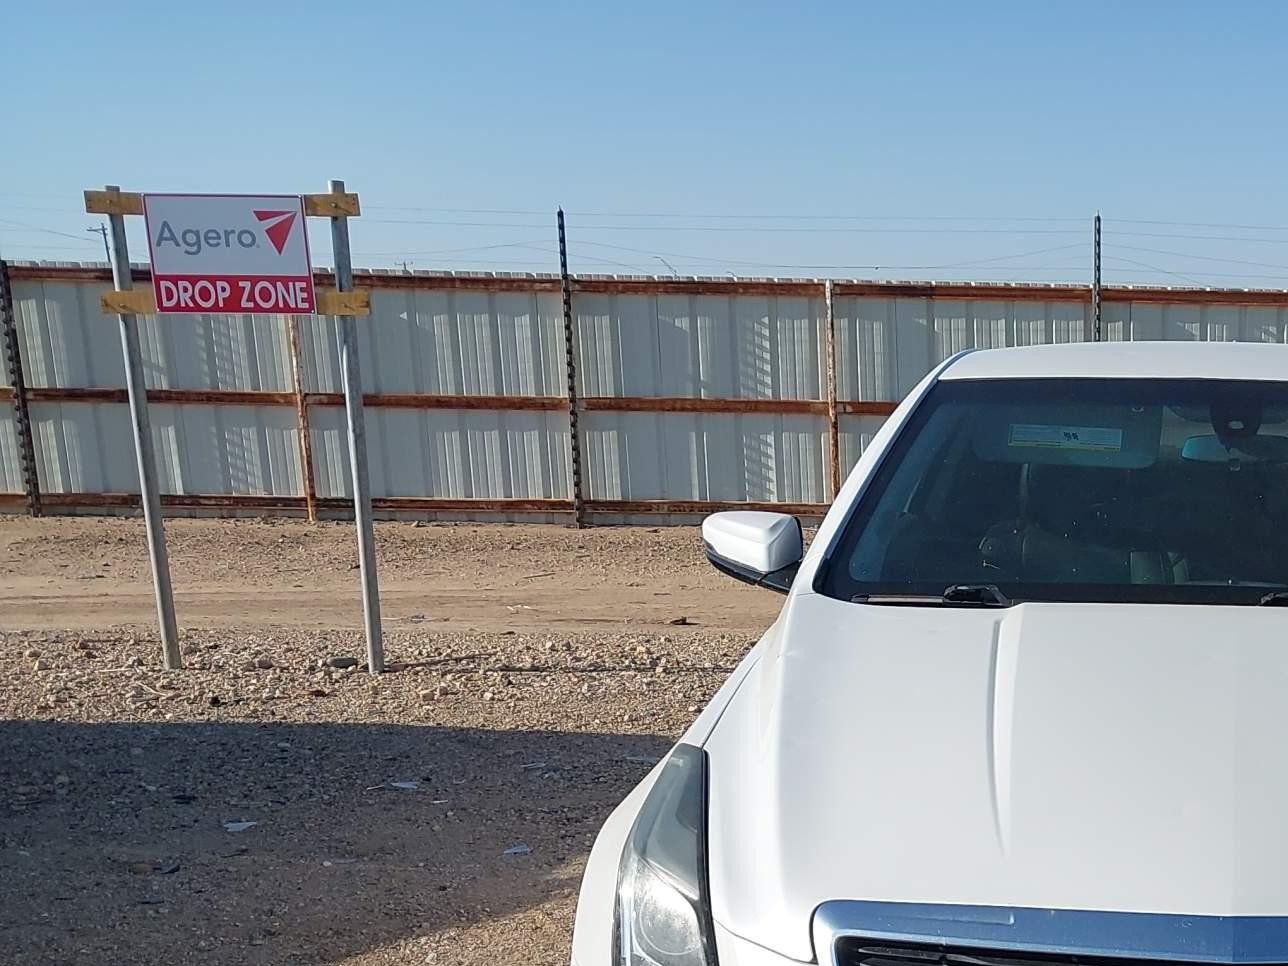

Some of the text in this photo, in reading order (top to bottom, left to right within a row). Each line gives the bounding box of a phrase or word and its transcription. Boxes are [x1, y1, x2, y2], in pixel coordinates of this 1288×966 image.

[156, 220, 257, 255] Agero
[160, 280, 310, 309] DROP ZONE
